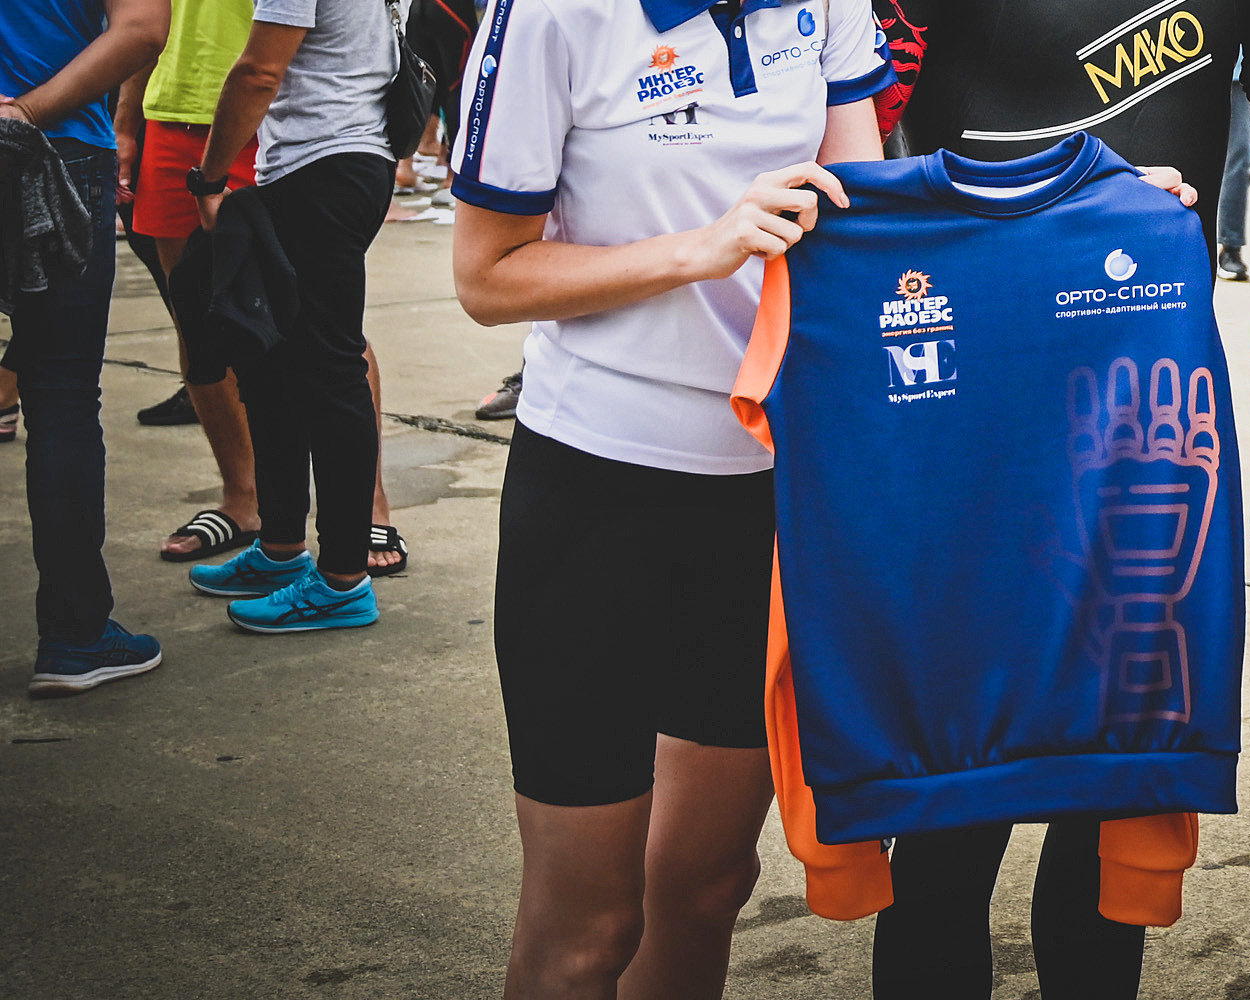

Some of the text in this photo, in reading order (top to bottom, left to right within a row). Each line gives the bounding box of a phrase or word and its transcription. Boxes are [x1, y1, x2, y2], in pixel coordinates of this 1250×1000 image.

[1084, 11, 1204, 104] MAKO
[638, 65, 696, 90] ИНТЕР
[1055, 282, 1185, 305] ОРТО-СПОРТ
[883, 296, 948, 315] ИНТЕР
[1055, 302, 1187, 318] спортивно-адаптивный центр
